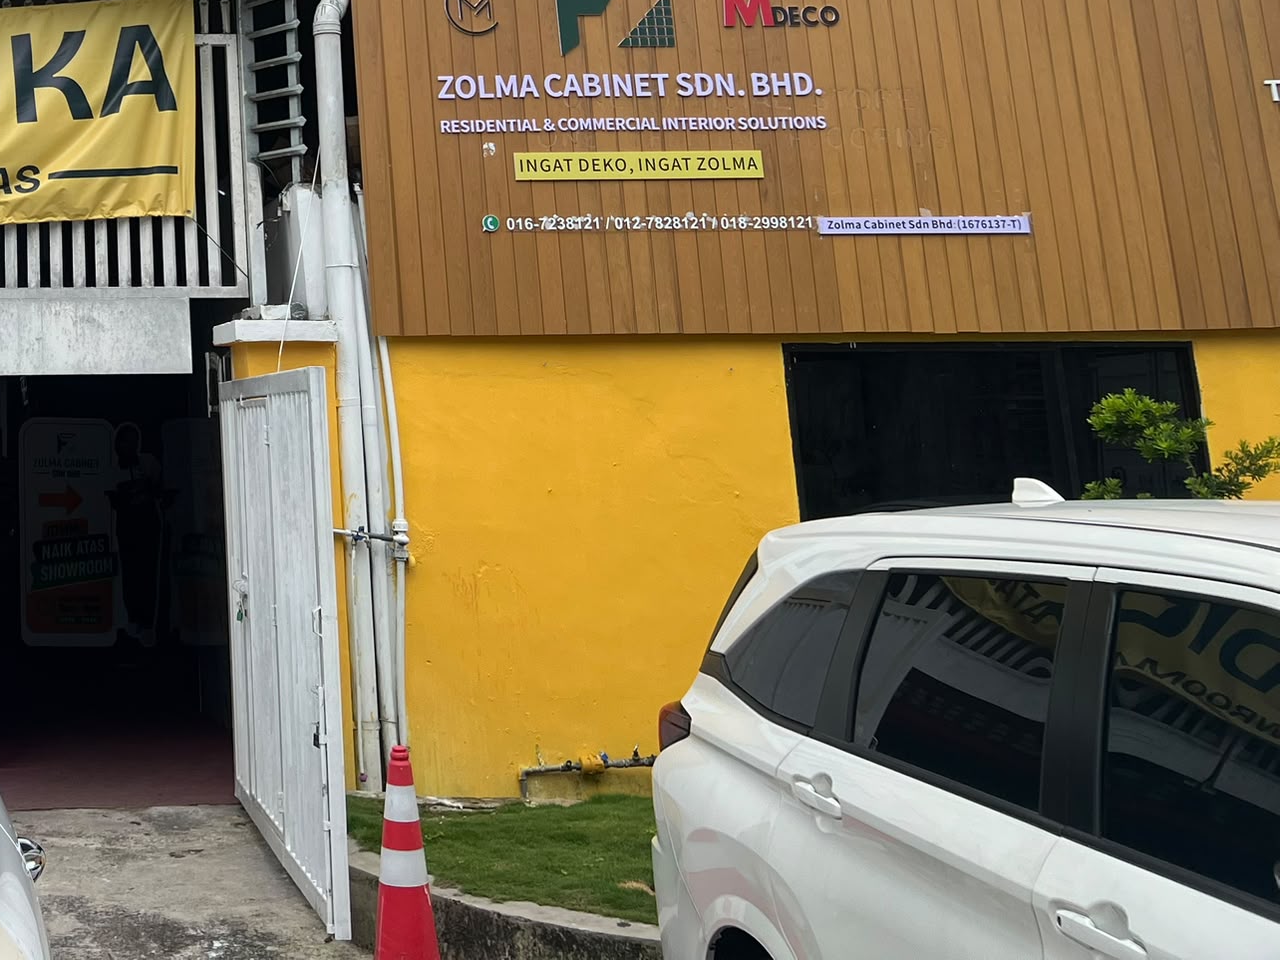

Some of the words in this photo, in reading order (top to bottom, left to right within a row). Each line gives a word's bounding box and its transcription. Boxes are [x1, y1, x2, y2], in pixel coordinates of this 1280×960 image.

[437, 74, 540, 100] ZOLMA
[543, 73, 669, 98] CABINET
[676, 72, 745, 98] SDN.
[751, 72, 823, 97] BHD.
[440, 118, 542, 133] RESIDENTIAL
[543, 118, 555, 132] &
[557, 117, 661, 132] COMMERCIAL
[662, 116, 736, 131] INTERIOR
[738, 115, 827, 130] SOLUTIONS
[520, 158, 573, 173] INGAT
[579, 158, 634, 175] DEKO,
[638, 157, 691, 172] INGAT
[697, 156, 759, 171] ZOLMA
[506, 216, 600, 231] 016-7238121
[614, 216, 706, 230] 012-7828121
[720, 215, 813, 230] 018-2998121
[827, 219, 862, 230] Zolma
[863, 219, 906, 229] Cabinet
[909, 219, 929, 229] Sdn
